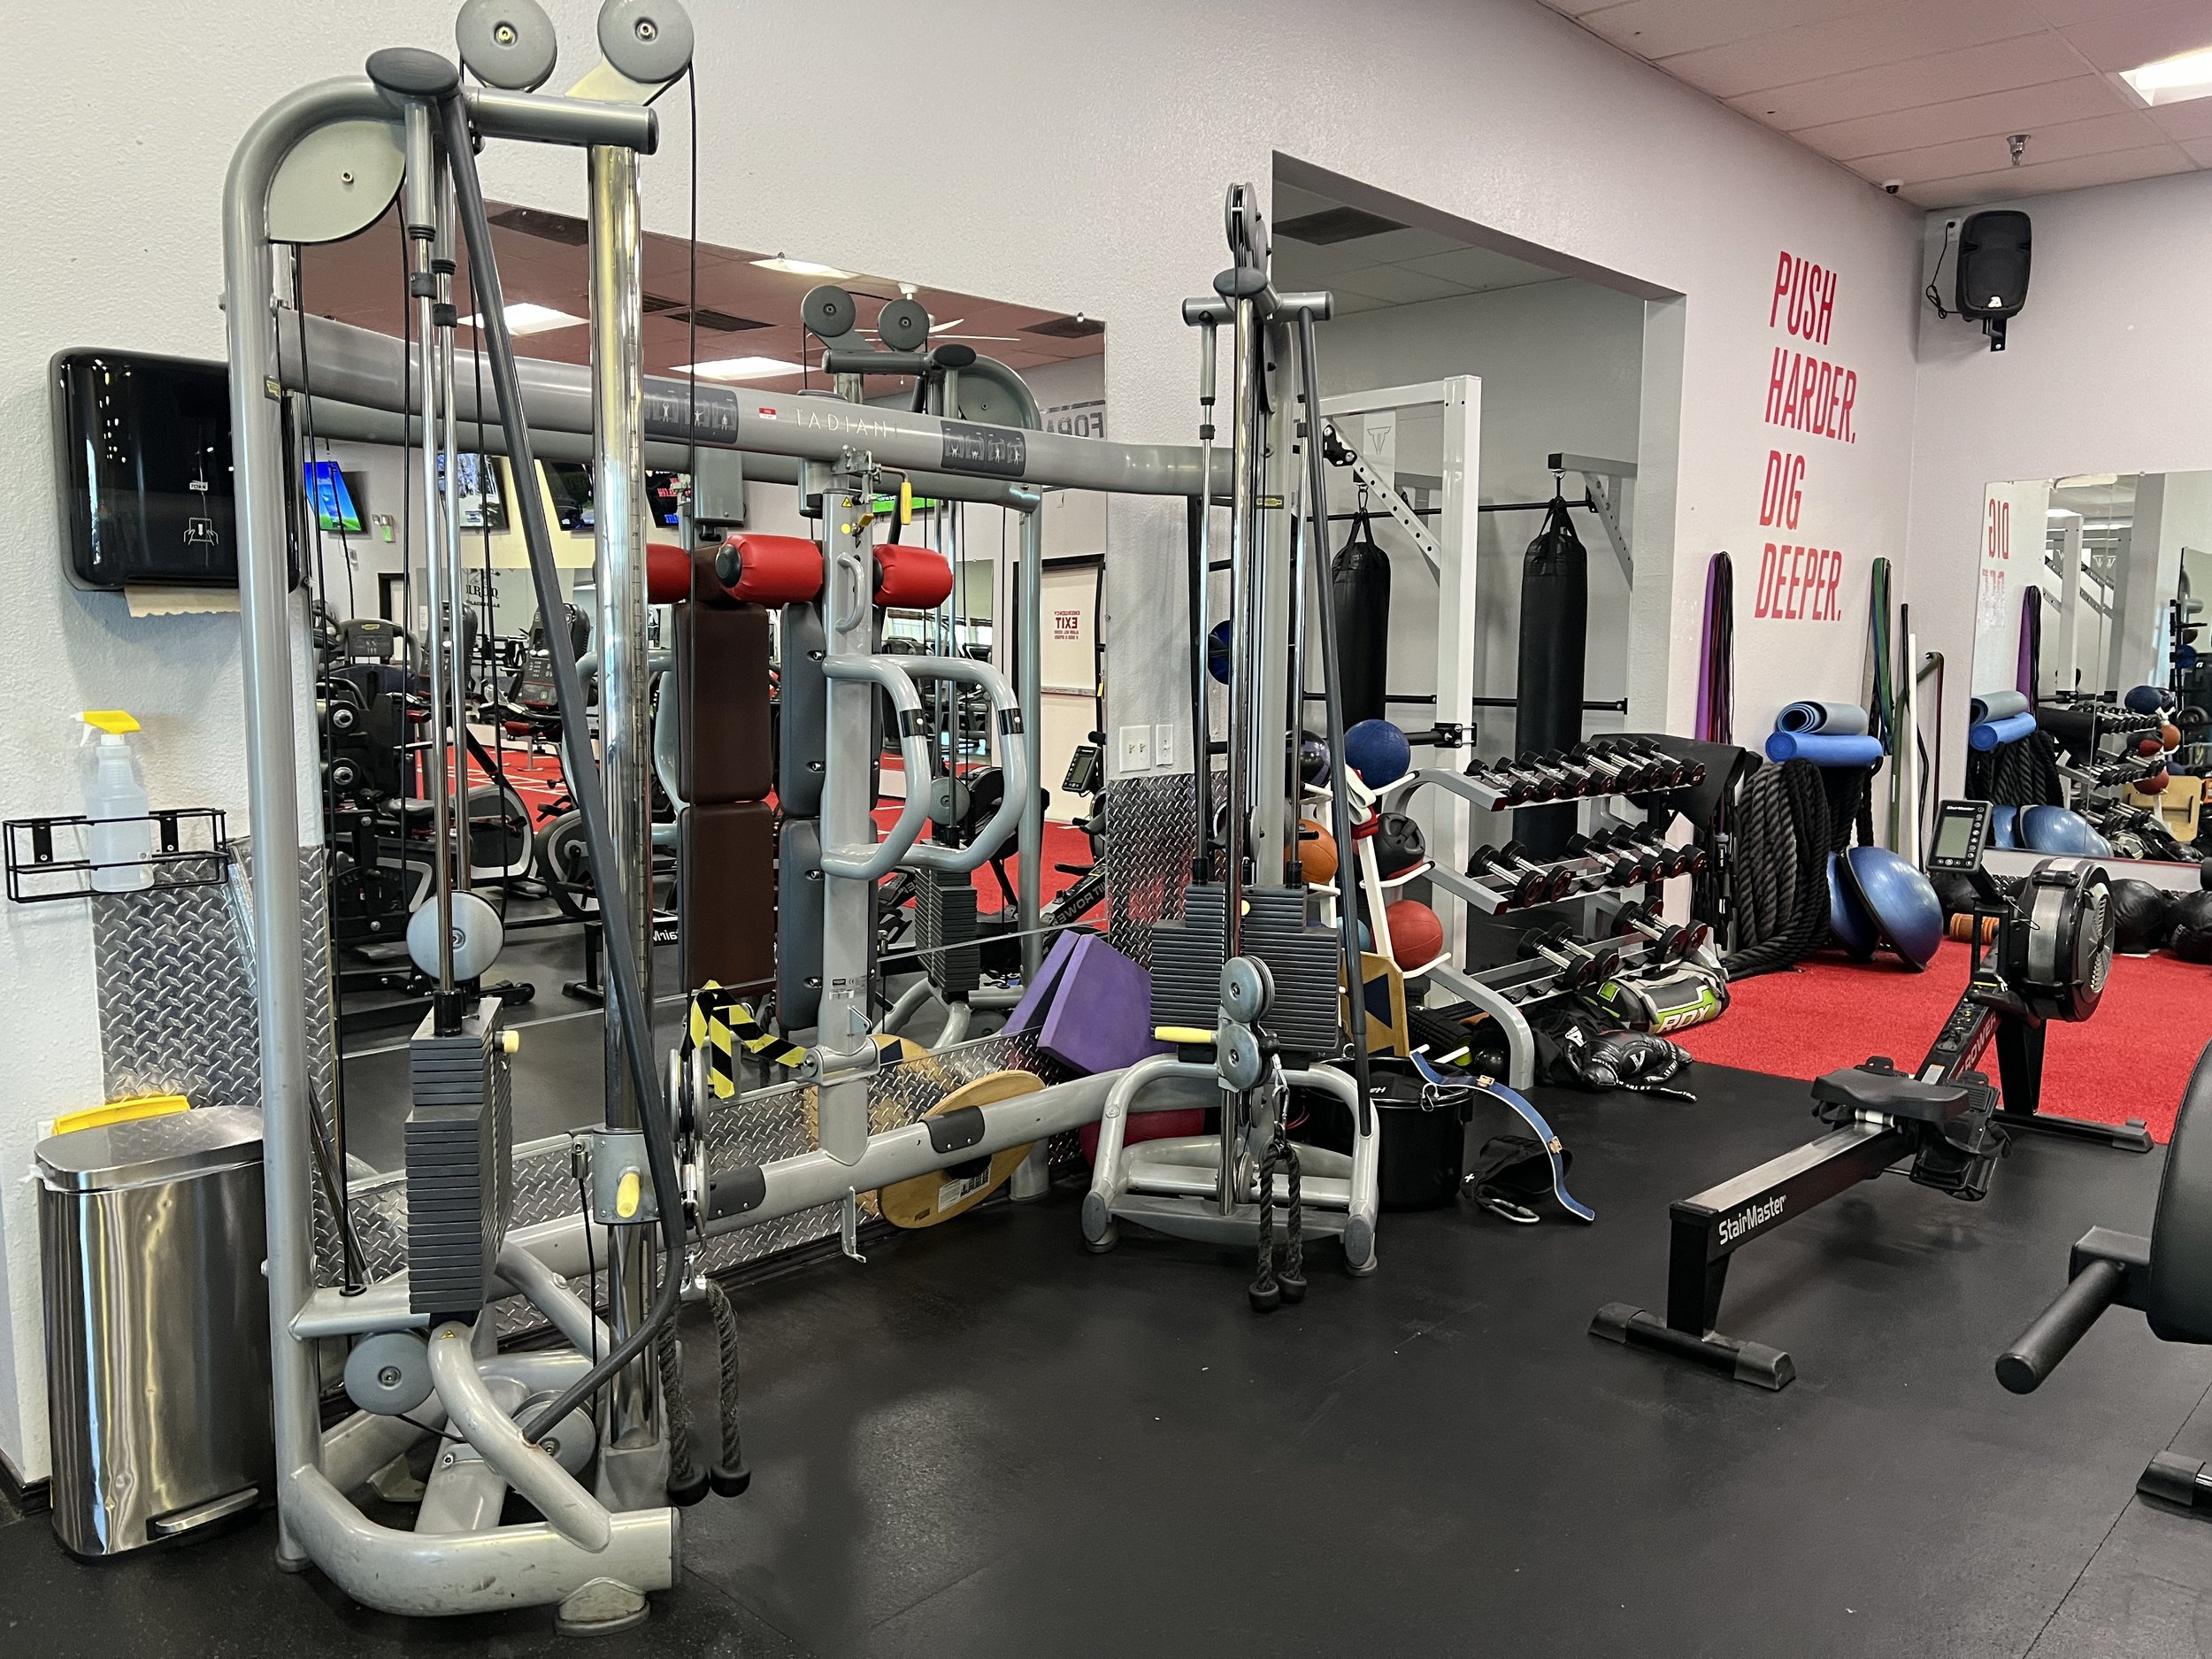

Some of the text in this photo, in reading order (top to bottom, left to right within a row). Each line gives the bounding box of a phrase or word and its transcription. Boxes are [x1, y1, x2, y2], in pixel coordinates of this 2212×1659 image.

[1770, 250, 1838, 346] PUSH
[1765, 347, 1857, 444] HARDER.
[1759, 449, 1806, 530] DIG
[1755, 542, 1843, 621] DEEPER.
[1655, 1003, 1712, 1034] RDX
[1718, 1195, 1786, 1246] StairMaster
